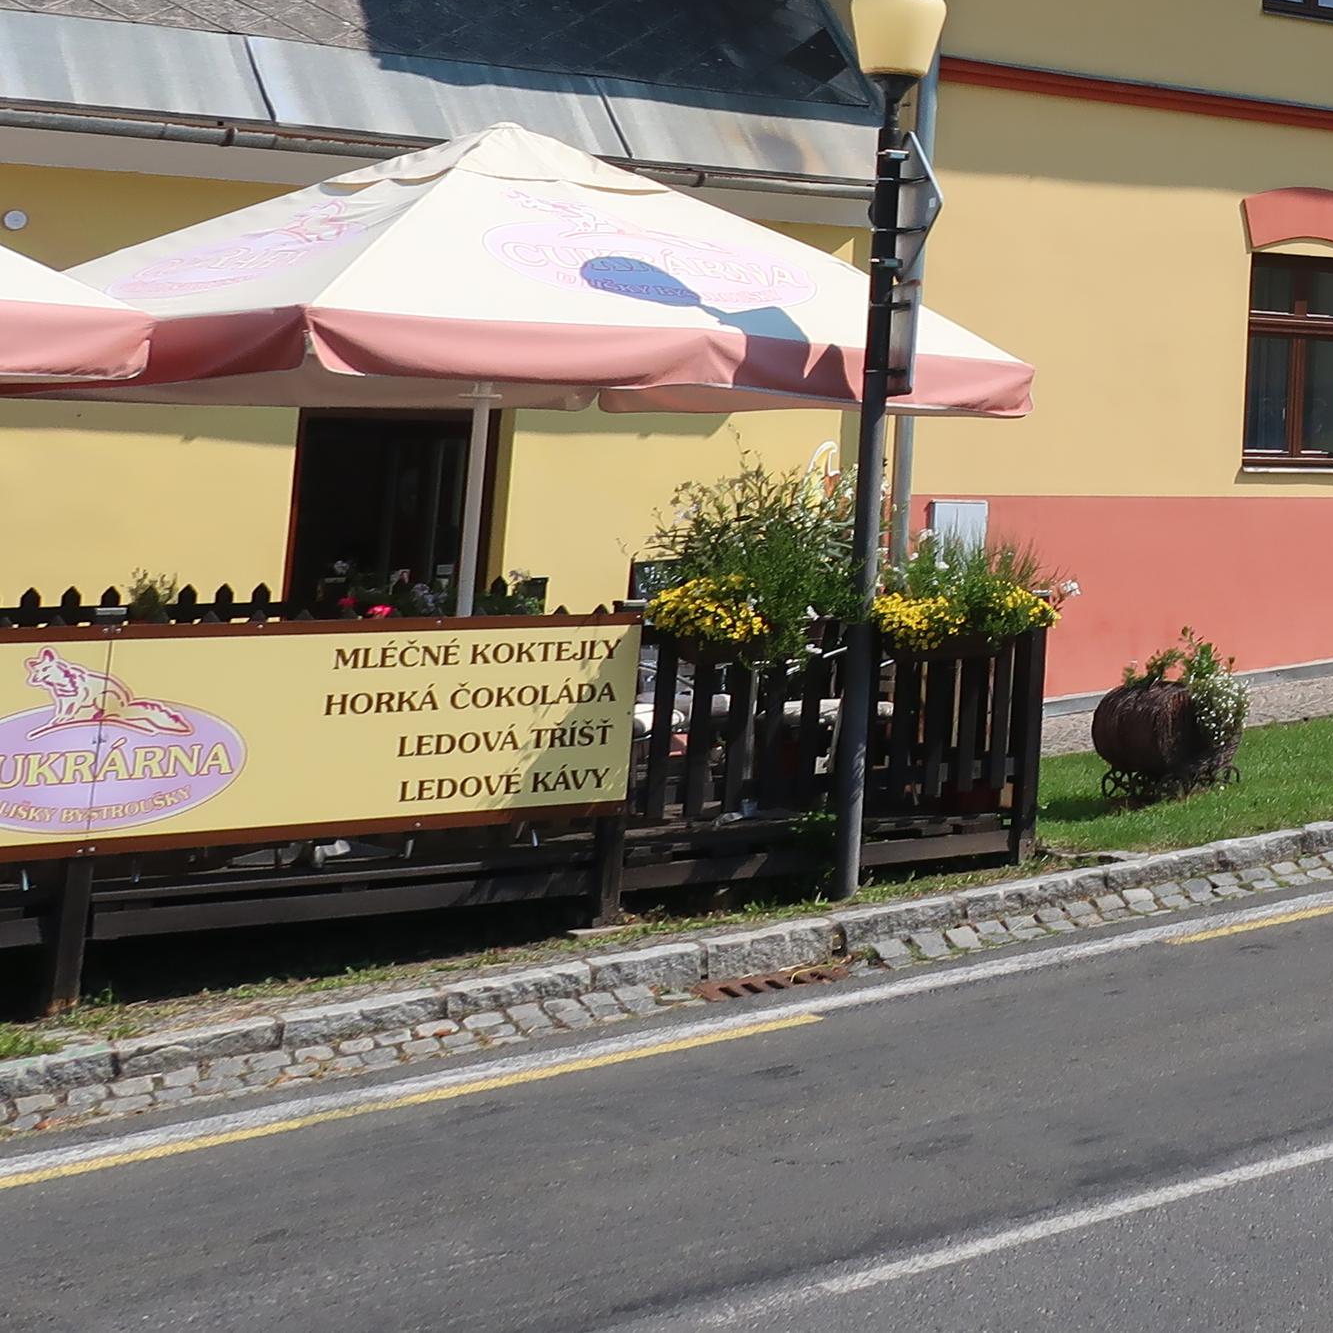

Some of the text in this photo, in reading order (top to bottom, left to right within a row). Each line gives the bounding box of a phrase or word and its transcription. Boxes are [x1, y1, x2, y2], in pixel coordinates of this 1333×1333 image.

[333, 638, 621, 670] MLÉČNÉ KOKTEJLY
[324, 677, 616, 716] HORKÁ ČOKOLÁDA
[397, 719, 613, 758] LEDOVÁ TŘÍŠŤ
[399, 764, 610, 803] LEDOVÉ KÁVY
